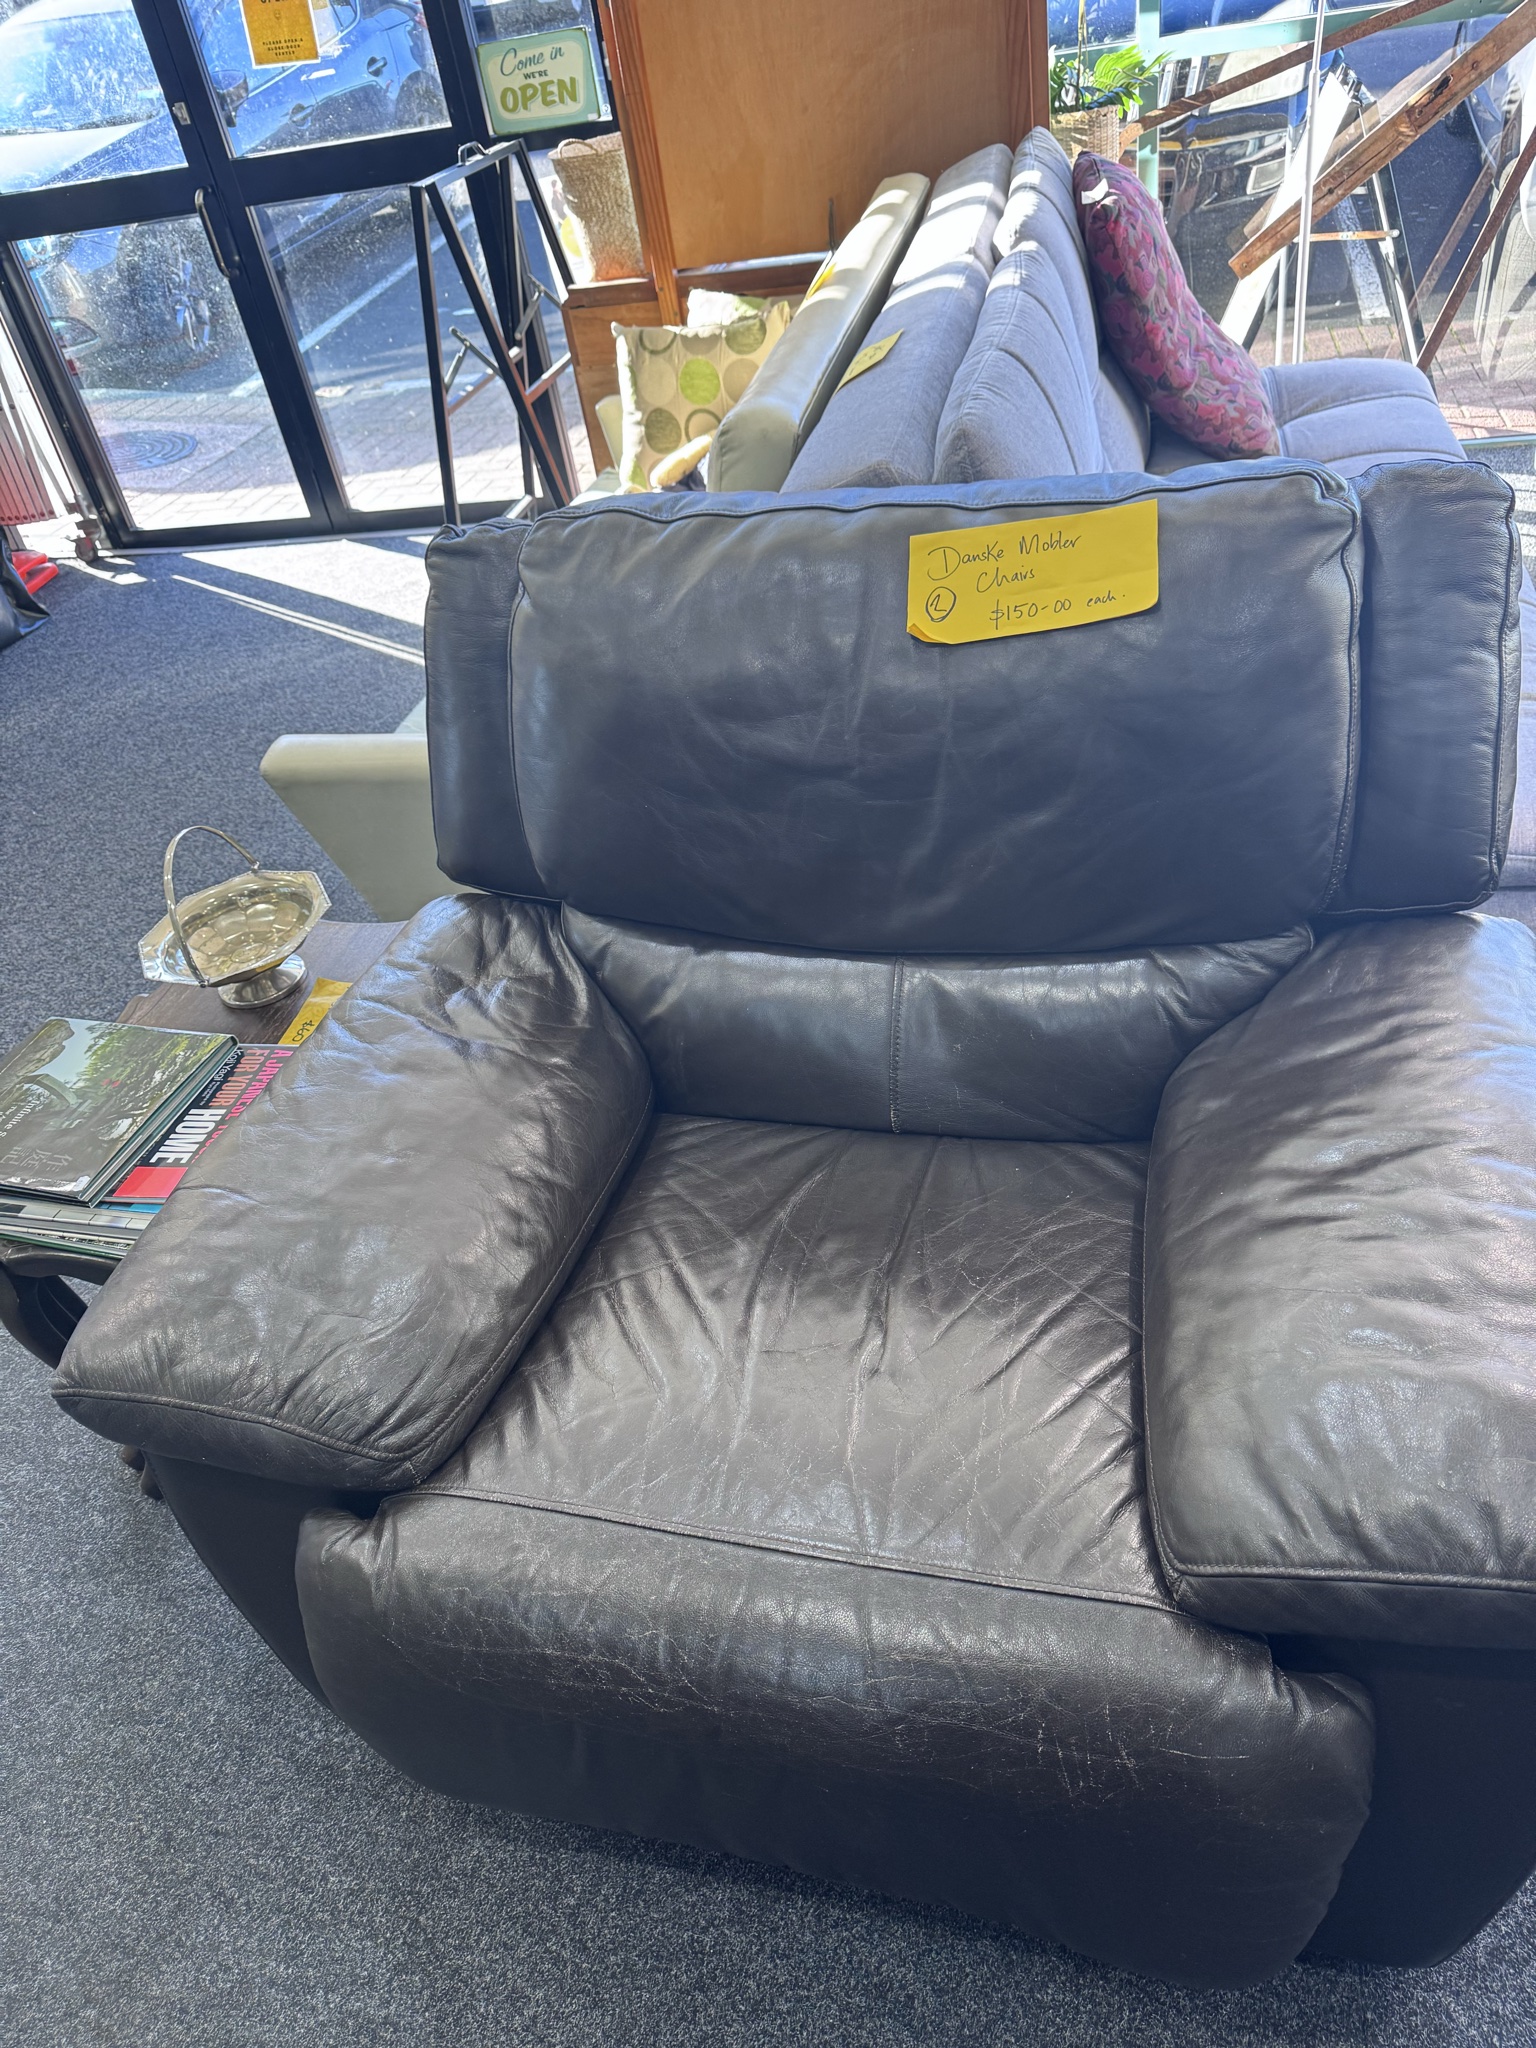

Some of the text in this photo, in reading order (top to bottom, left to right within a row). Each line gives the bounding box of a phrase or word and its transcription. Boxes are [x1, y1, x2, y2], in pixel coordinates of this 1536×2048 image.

[500, 46, 565, 76] Come in
[523, 69, 549, 80] WE'RE
[500, 76, 579, 113] OPEN
[927, 530, 1082, 581] Danske Mobler
[976, 565, 1035, 593] Chairs
[233, 1049, 271, 1072] FOR
[271, 1049, 294, 1058] A
[208, 1074, 254, 1107] YOUR
[4, 1100, 40, 1130] Infinite
[149, 1108, 227, 1164] HOME
